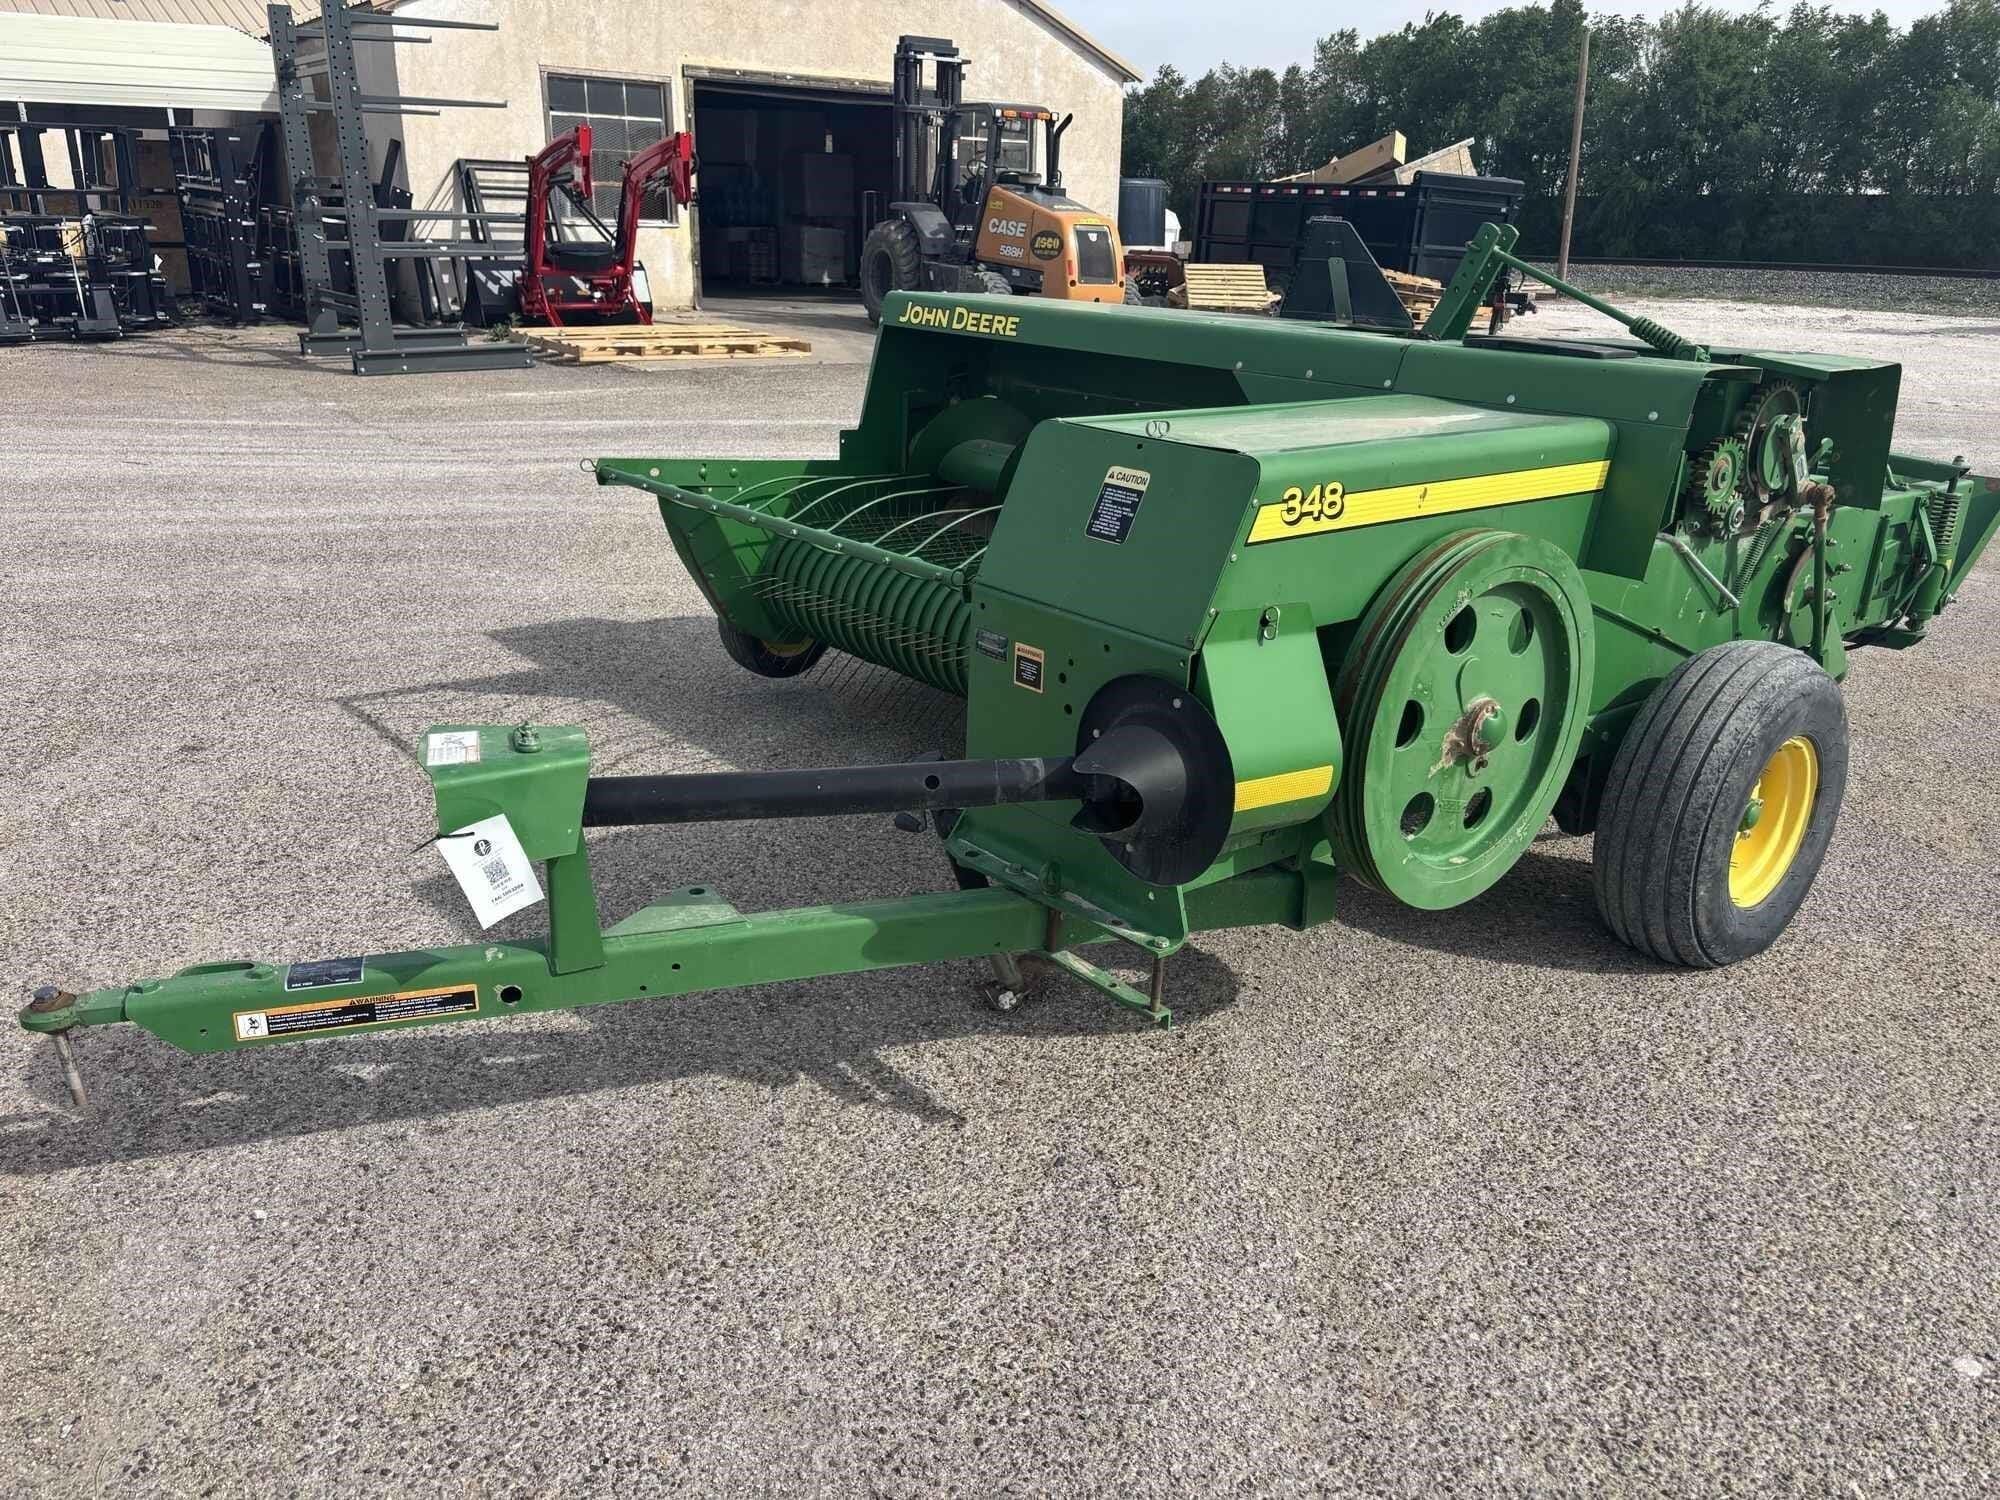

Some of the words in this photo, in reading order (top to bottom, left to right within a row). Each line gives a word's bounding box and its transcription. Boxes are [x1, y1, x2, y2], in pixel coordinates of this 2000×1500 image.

[988, 218, 1028, 238] CASE
[999, 244, 1024, 258] 588H
[899, 301, 950, 328] JOHN
[951, 306, 1020, 337] DEERE
[1116, 472, 1148, 486] CAUTION
[1281, 481, 1345, 526] 348
[356, 994, 396, 1005] WARNING
